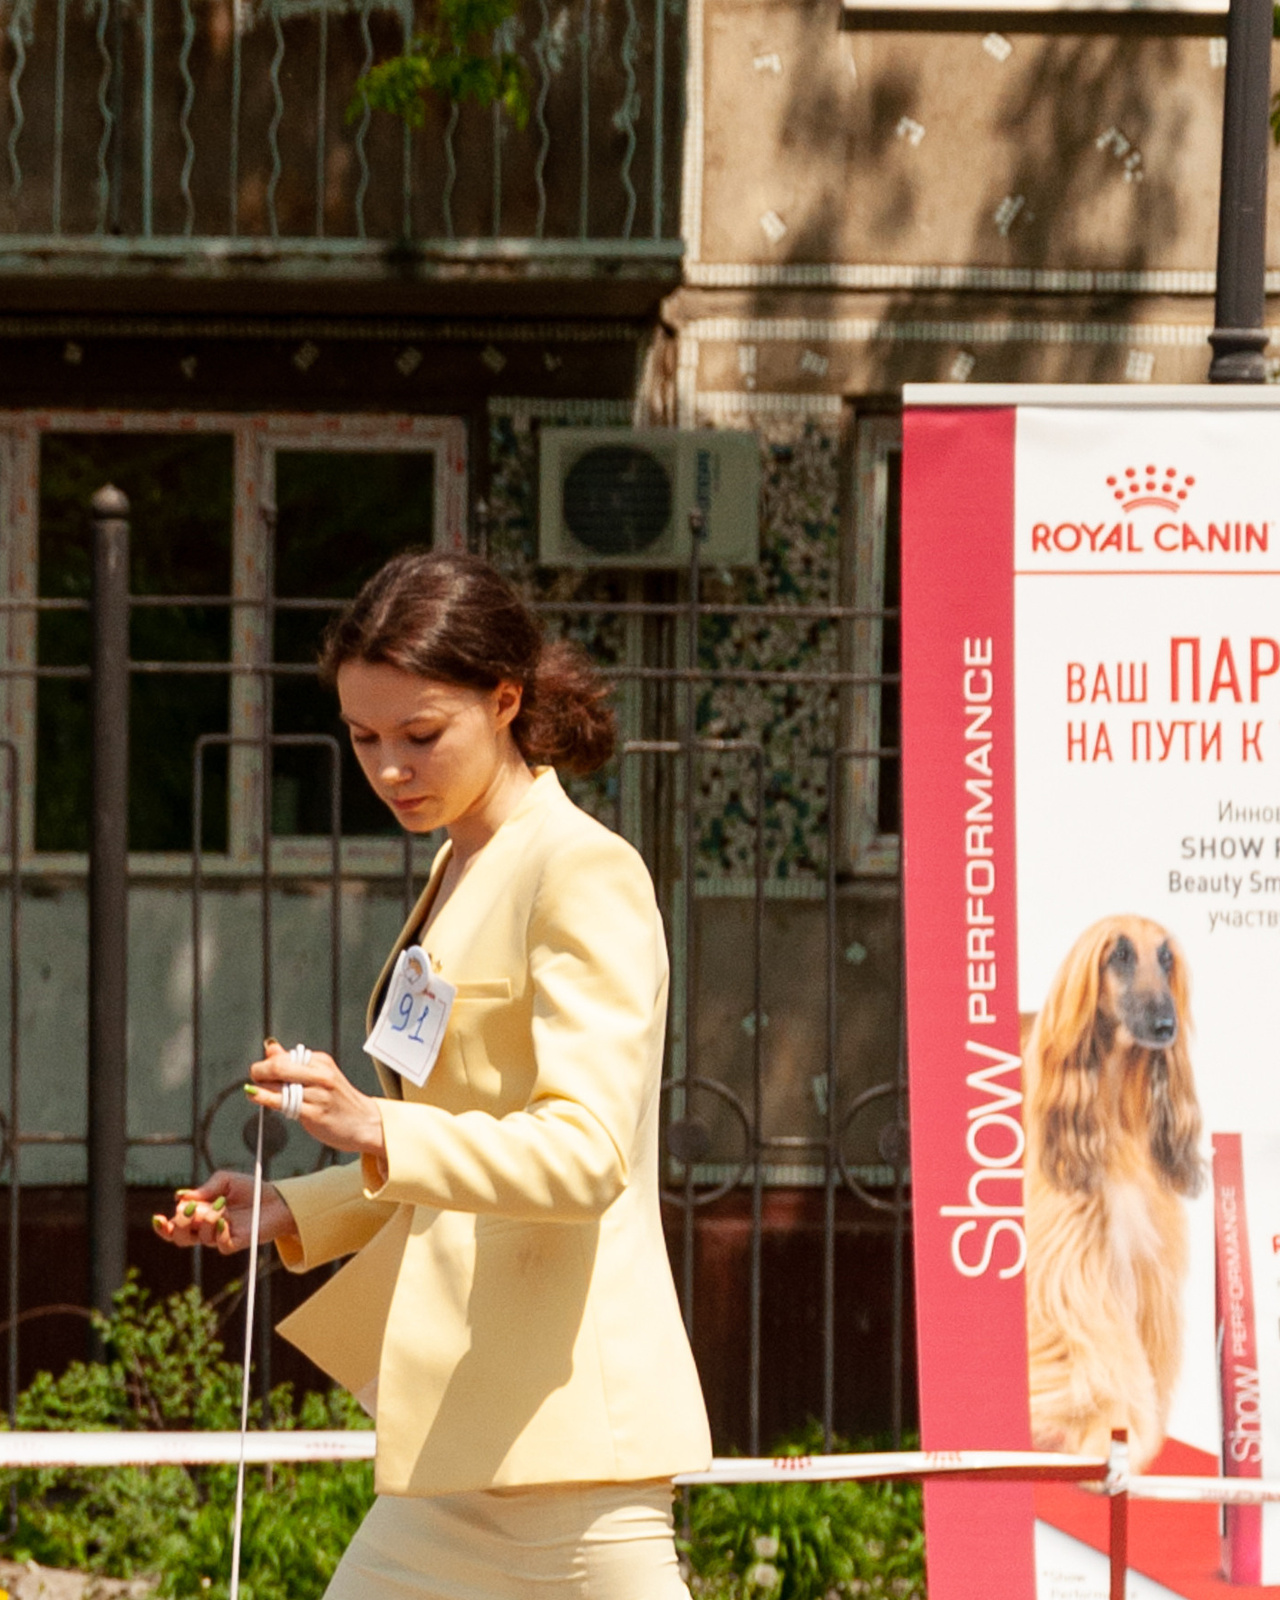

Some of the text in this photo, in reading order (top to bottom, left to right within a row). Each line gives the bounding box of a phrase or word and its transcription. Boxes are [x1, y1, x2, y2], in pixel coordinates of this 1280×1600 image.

[1031, 521, 1269, 553] ROYAL CANIN
[1066, 635, 1280, 704] ВАШ ПАР
[1066, 720, 1264, 763] НА ПУТИ К
[1180, 835, 1265, 860] SHOW
[1168, 868, 1243, 899] Beauty
[939, 636, 1028, 1280] Show PERFORMANCE
[390, 992, 430, 1044] 91
